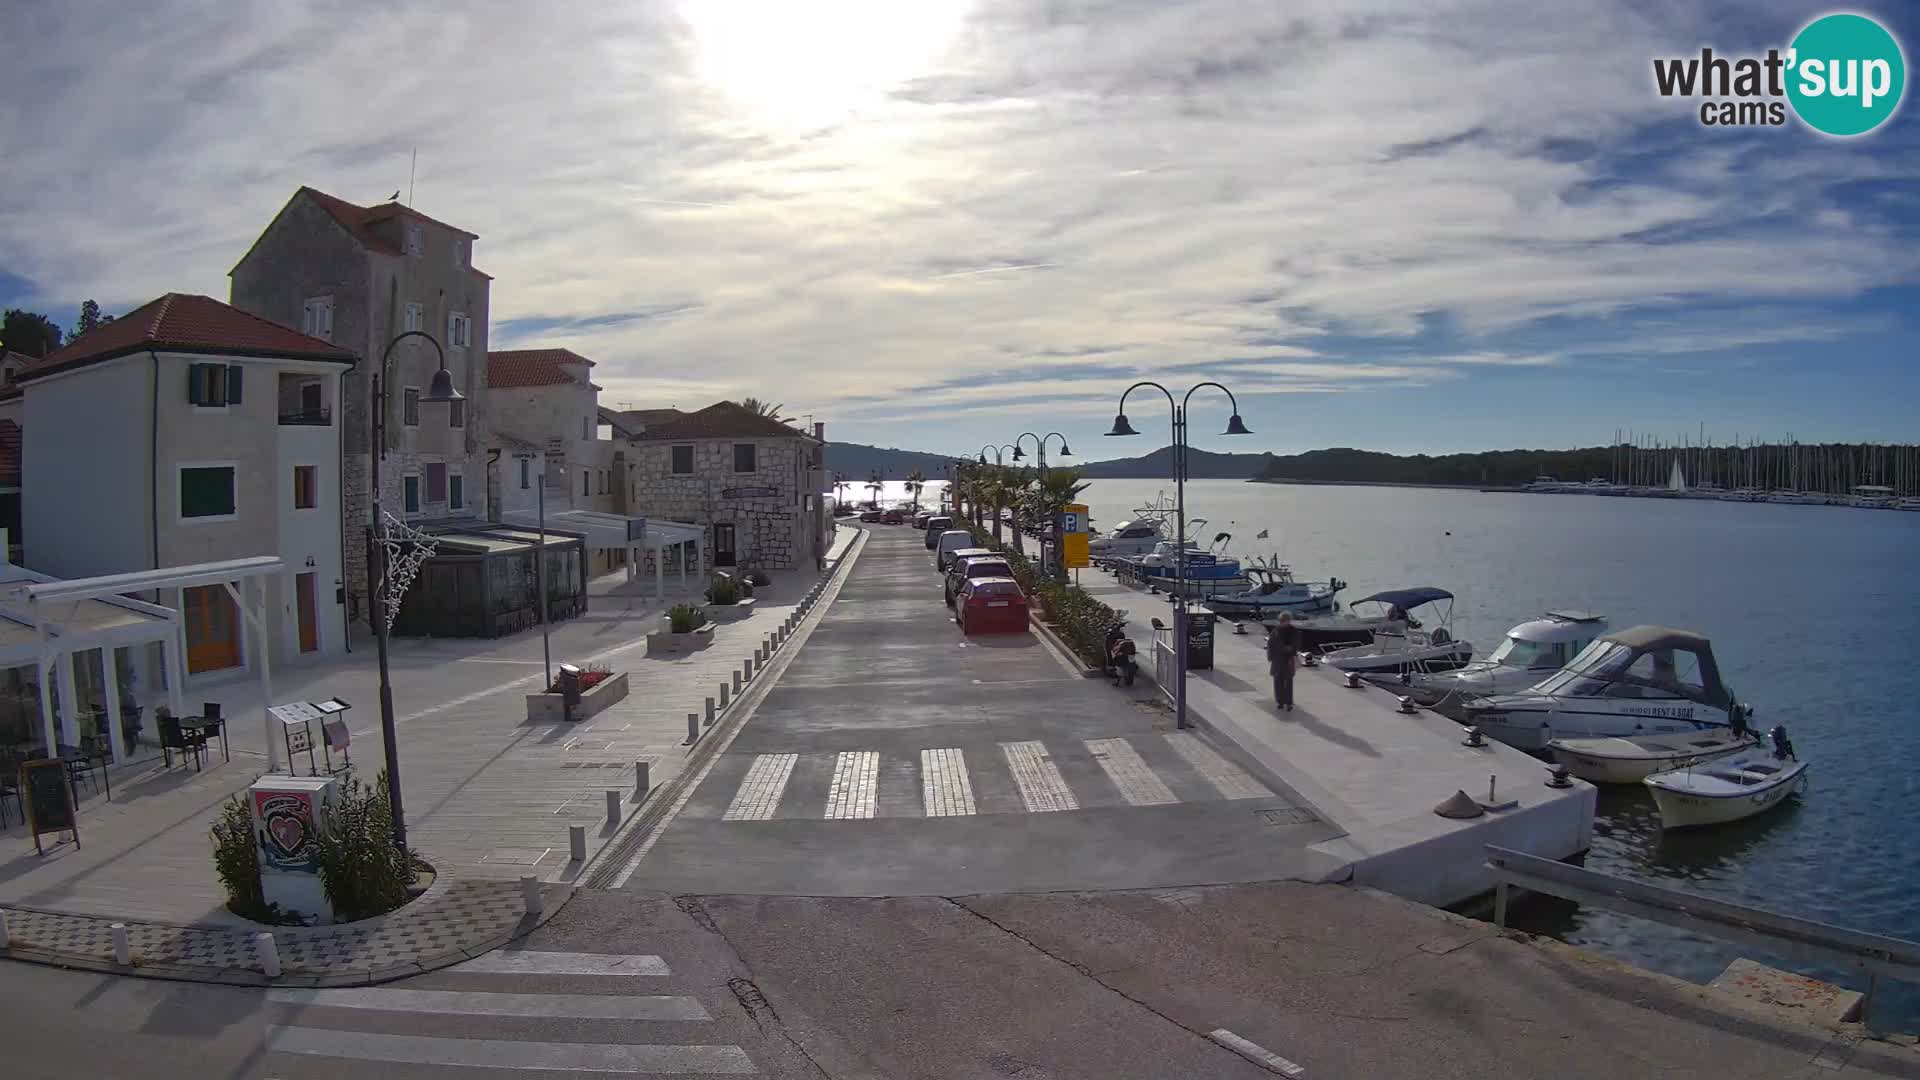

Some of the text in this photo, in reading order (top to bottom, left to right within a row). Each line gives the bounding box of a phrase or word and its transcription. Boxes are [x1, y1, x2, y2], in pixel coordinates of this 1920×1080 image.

[1065, 514, 1076, 531] P
[1653, 707, 1670, 718] RENT
[1677, 708, 1694, 719] BOAT
